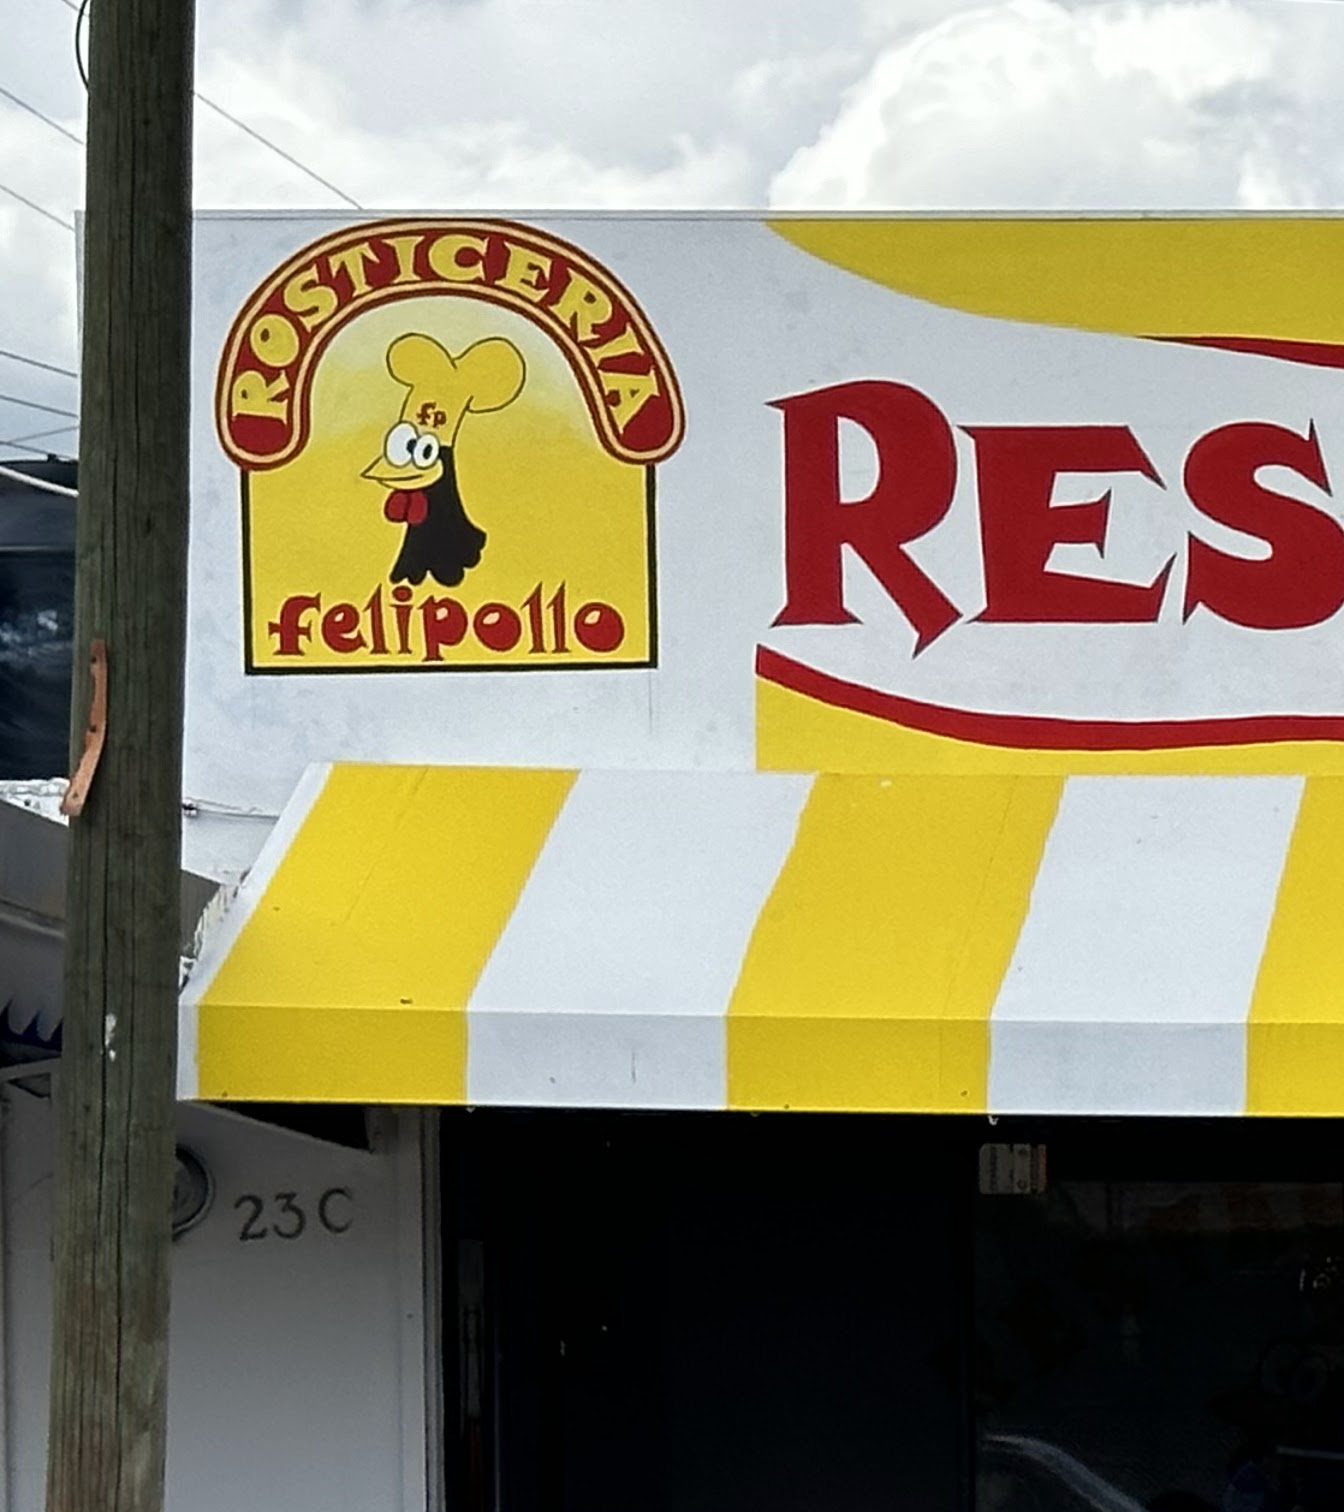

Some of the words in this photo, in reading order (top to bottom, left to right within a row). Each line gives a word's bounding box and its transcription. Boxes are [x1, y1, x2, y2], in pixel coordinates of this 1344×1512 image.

[232, 235, 661, 434] ROSTICERIA
[416, 402, 447, 428] fp
[268, 581, 625, 661] felipollo
